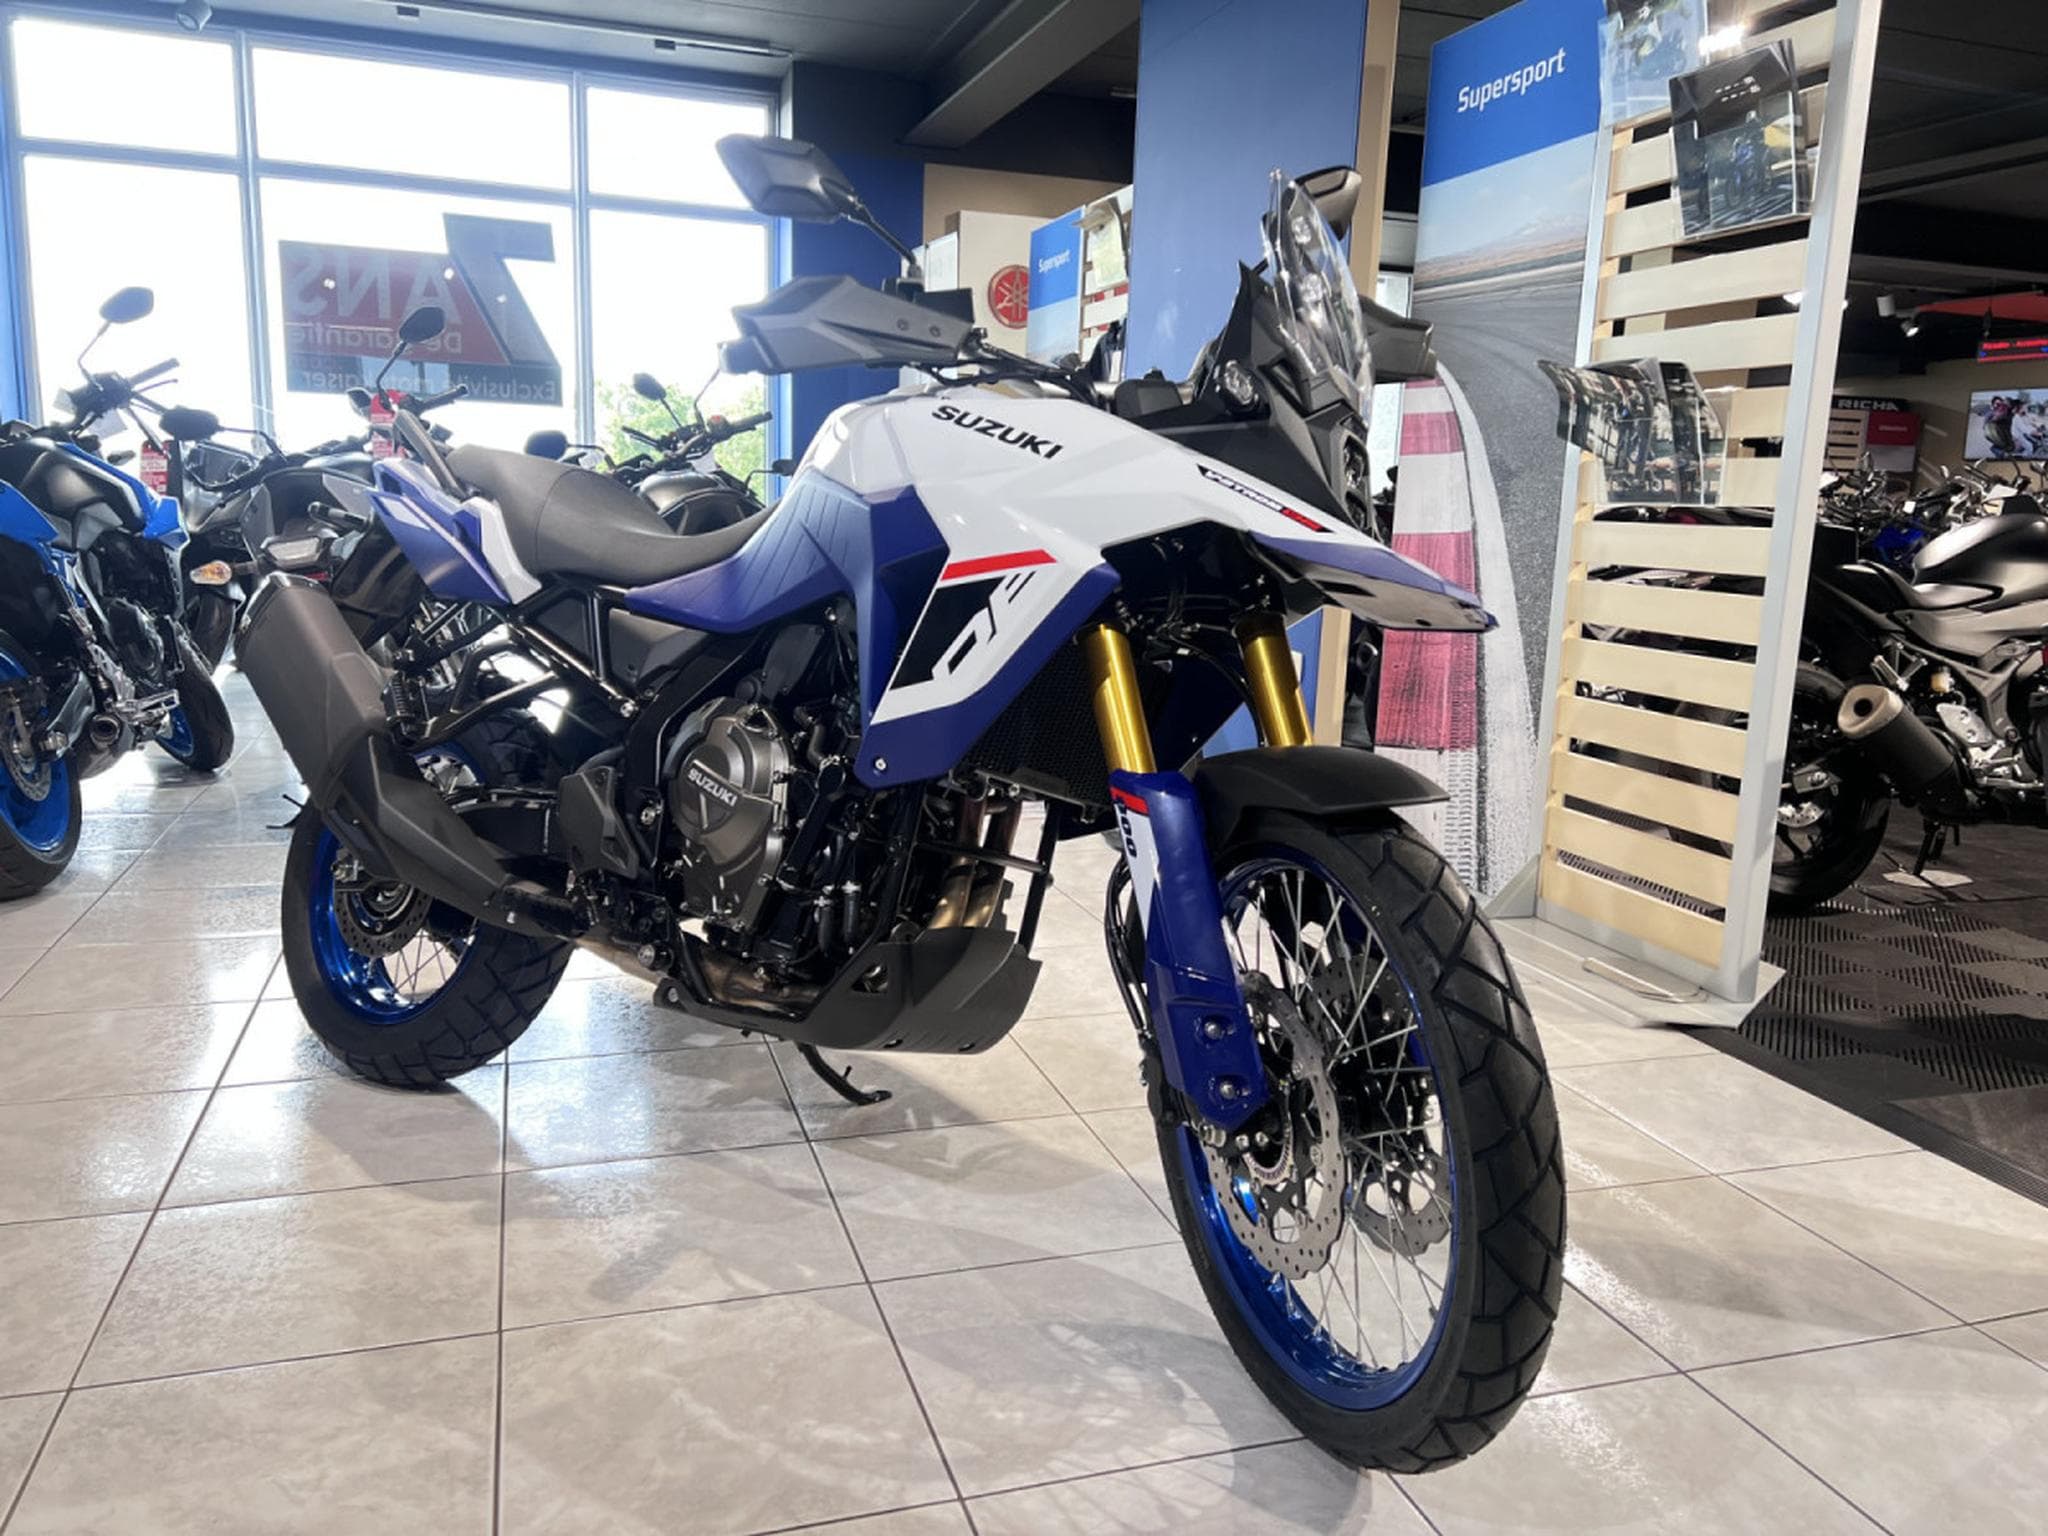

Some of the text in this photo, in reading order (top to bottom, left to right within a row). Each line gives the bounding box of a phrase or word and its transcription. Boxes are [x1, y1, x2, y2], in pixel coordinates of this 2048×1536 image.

[1457, 47, 1566, 113] Supersport
[1837, 399, 1899, 411] RICHA
[931, 405, 1063, 459] SUZUKI
[687, 767, 738, 807] SUZUKI
